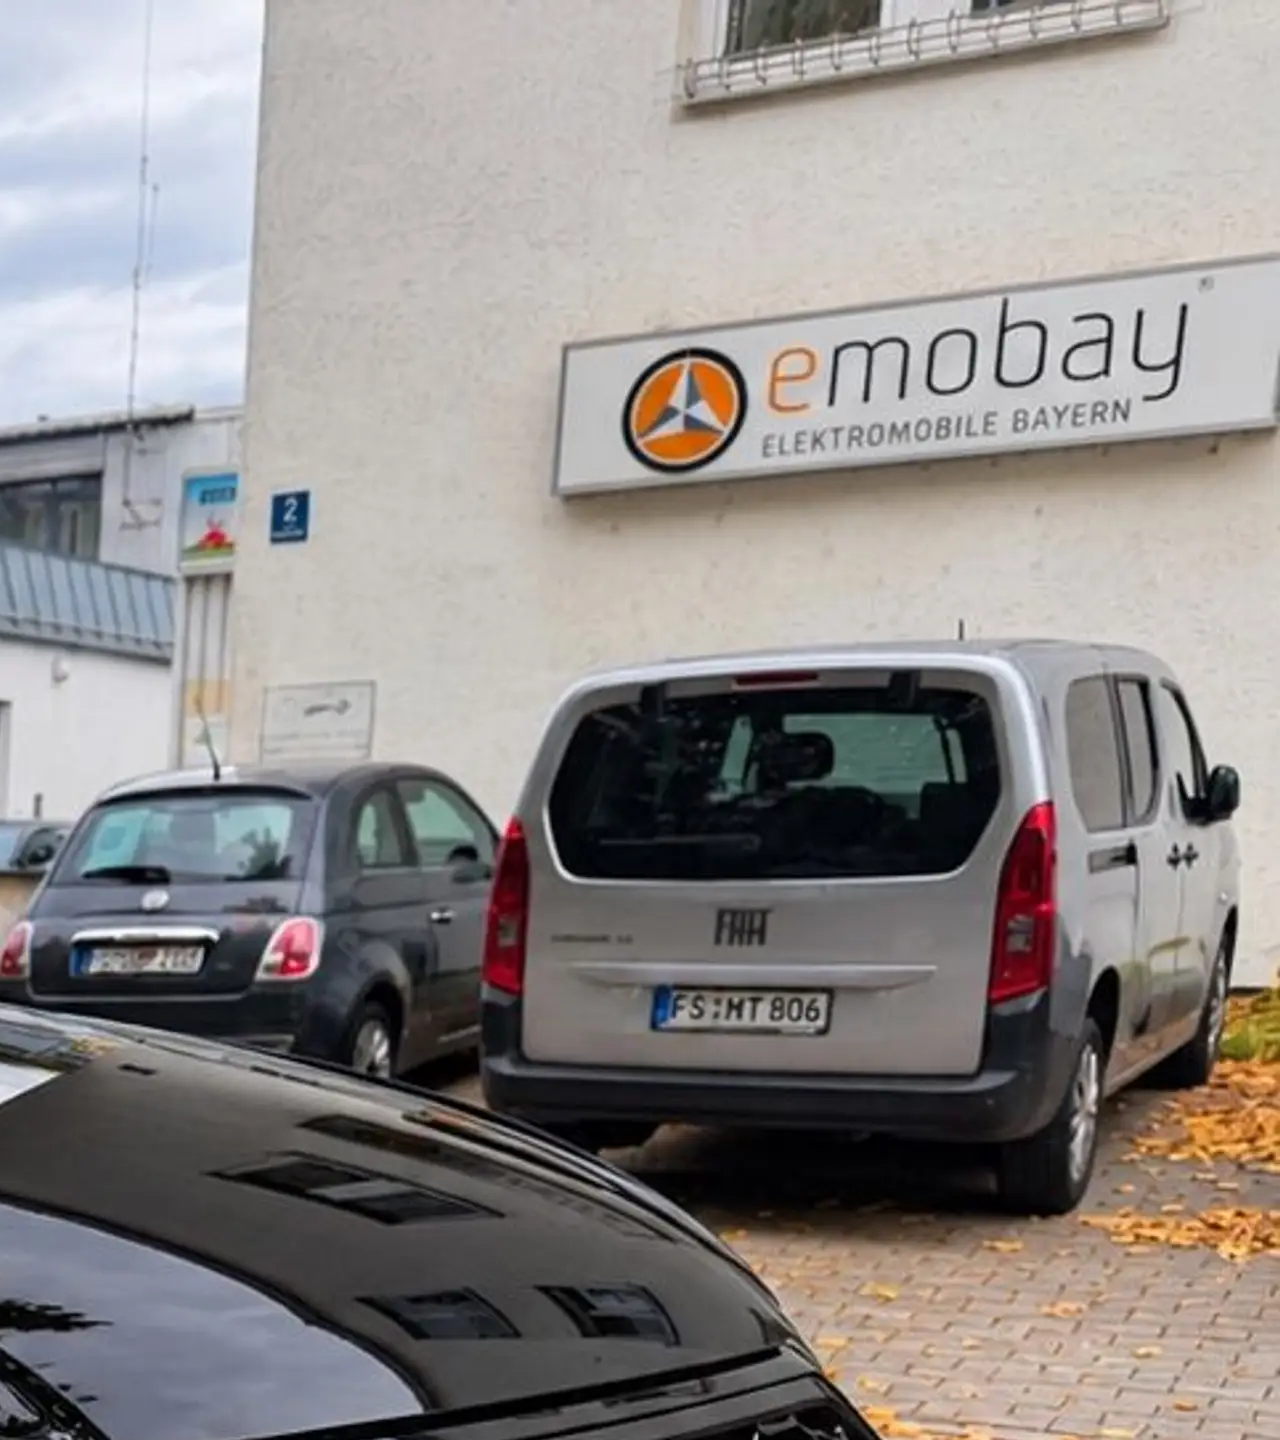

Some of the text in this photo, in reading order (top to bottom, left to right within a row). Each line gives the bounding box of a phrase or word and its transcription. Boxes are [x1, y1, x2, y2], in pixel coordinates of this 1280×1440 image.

[766, 297, 1189, 415] emobay
[761, 399, 1133, 458] ELEKTROMOBILE BAYERN
[283, 497, 298, 523] 2
[670, 994, 706, 1021] FS
[768, 996, 821, 1022] 806
